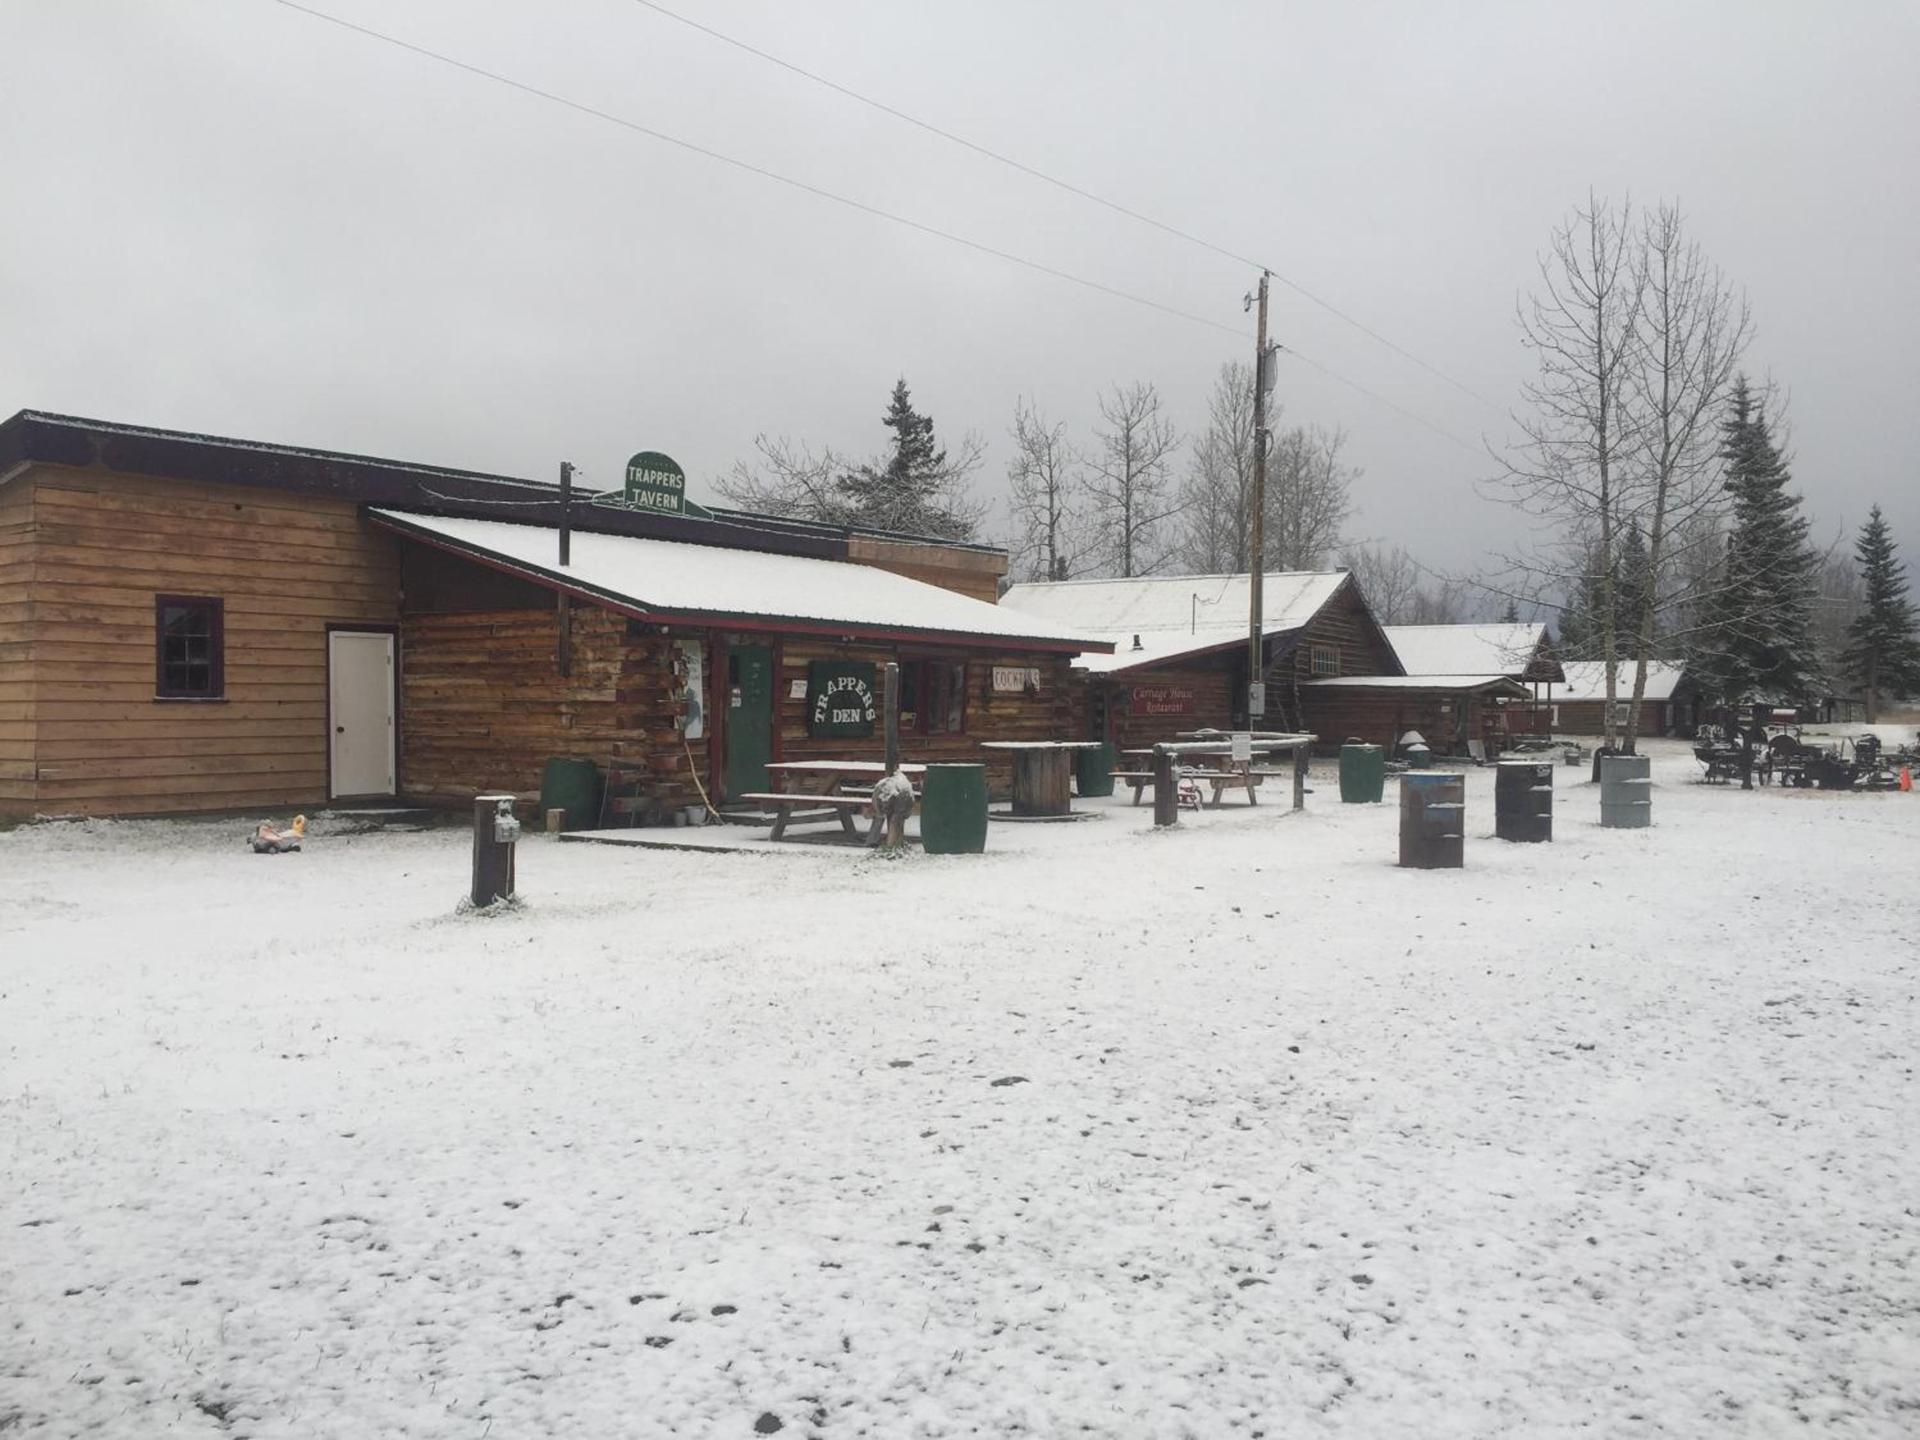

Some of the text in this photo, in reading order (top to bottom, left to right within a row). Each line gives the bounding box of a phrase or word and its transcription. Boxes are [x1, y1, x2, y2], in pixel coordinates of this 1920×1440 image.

[629, 466, 683, 489] TRAPPERS
[632, 488, 678, 510] TAVERN
[995, 670, 1039, 690] COCKTS
[814, 676, 876, 723] TRAPPERS
[832, 708, 861, 723] DEN
